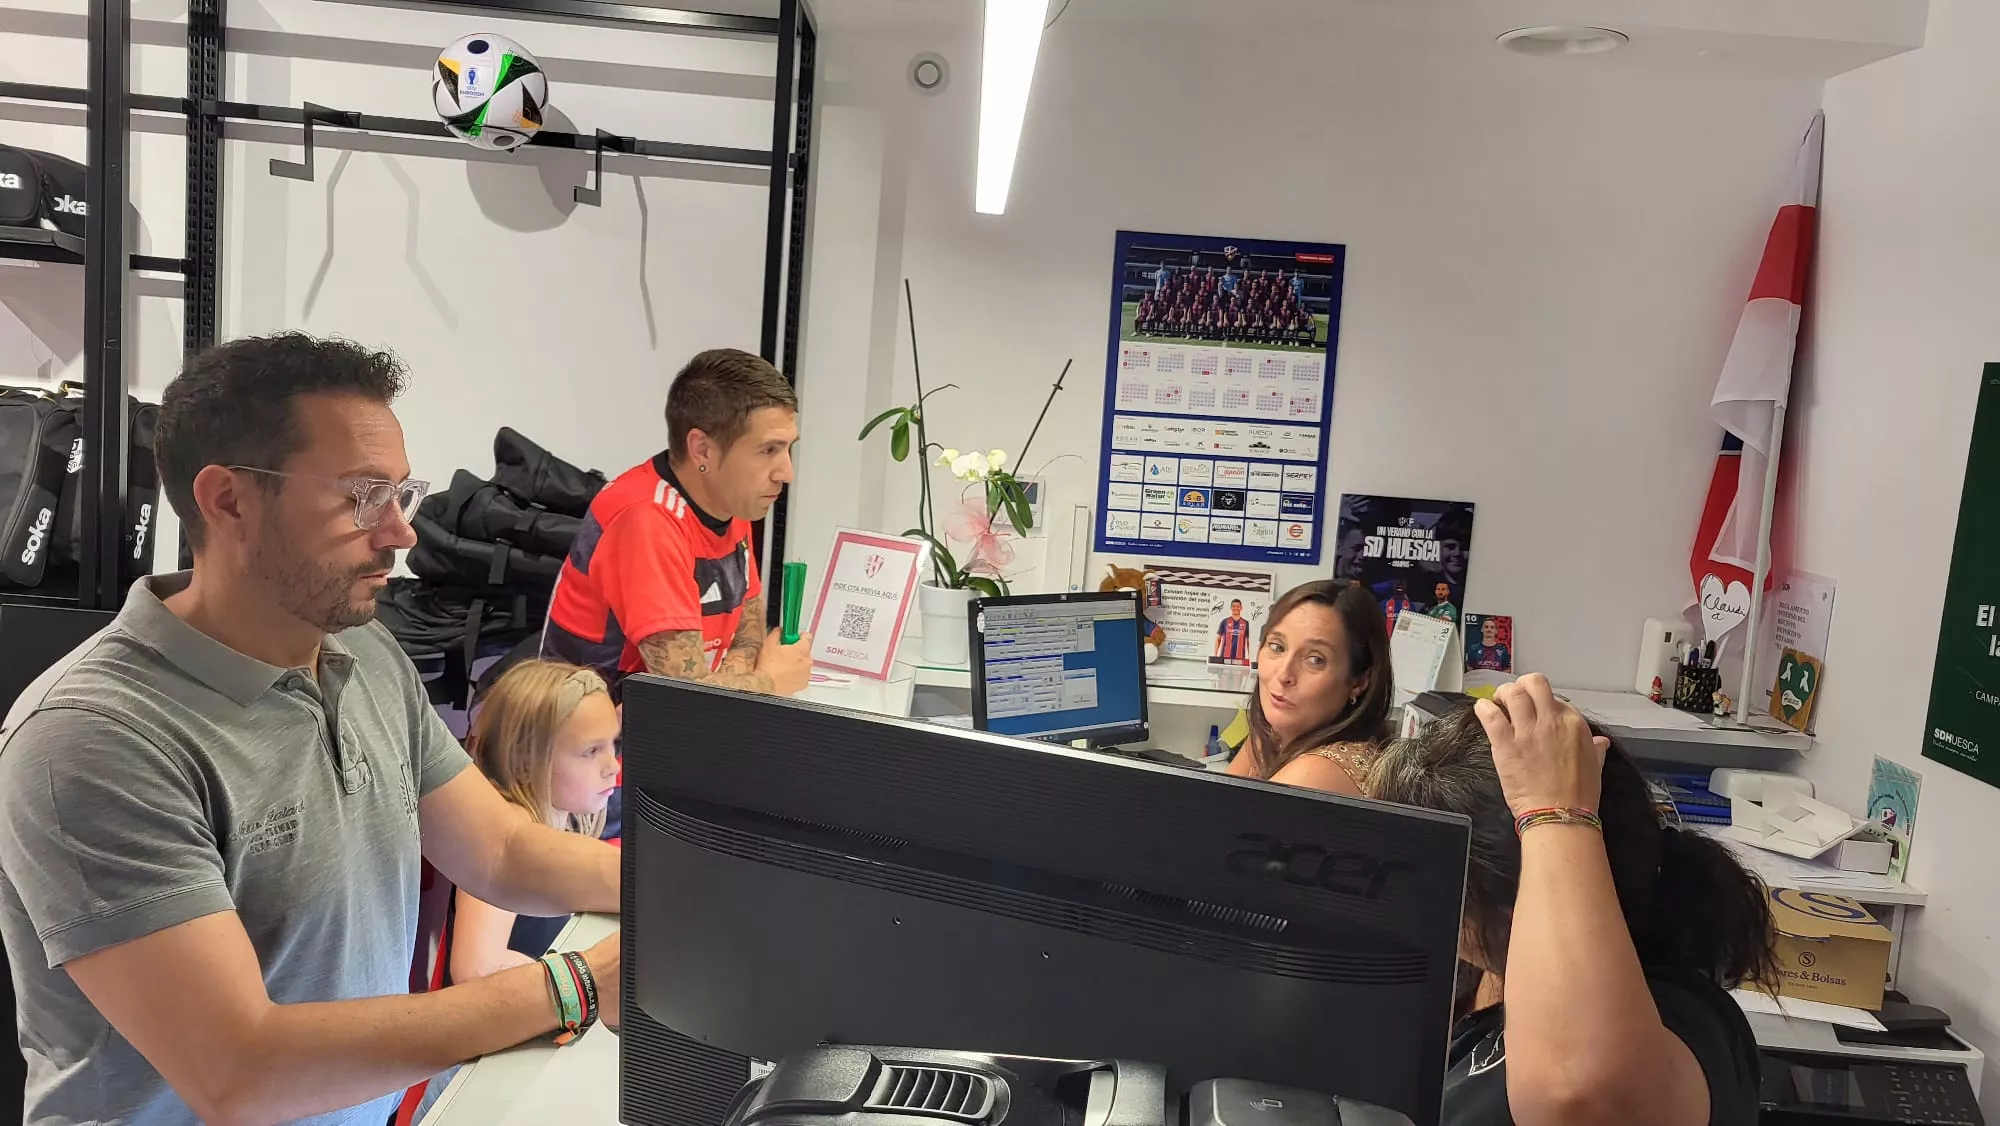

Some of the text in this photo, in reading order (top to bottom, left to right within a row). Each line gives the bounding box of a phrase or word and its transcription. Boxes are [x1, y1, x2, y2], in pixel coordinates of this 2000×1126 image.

[21, 507, 52, 566] soka
[133, 503, 152, 560] soka
[1363, 535, 1441, 561] SD HUESCA
[1976, 604, 1996, 627] El
[1933, 727, 1979, 755] SDHUESCA
[1226, 832, 1419, 900] acer
[1799, 970, 1810, 981] &
[1812, 972, 1847, 986] Bolsas
